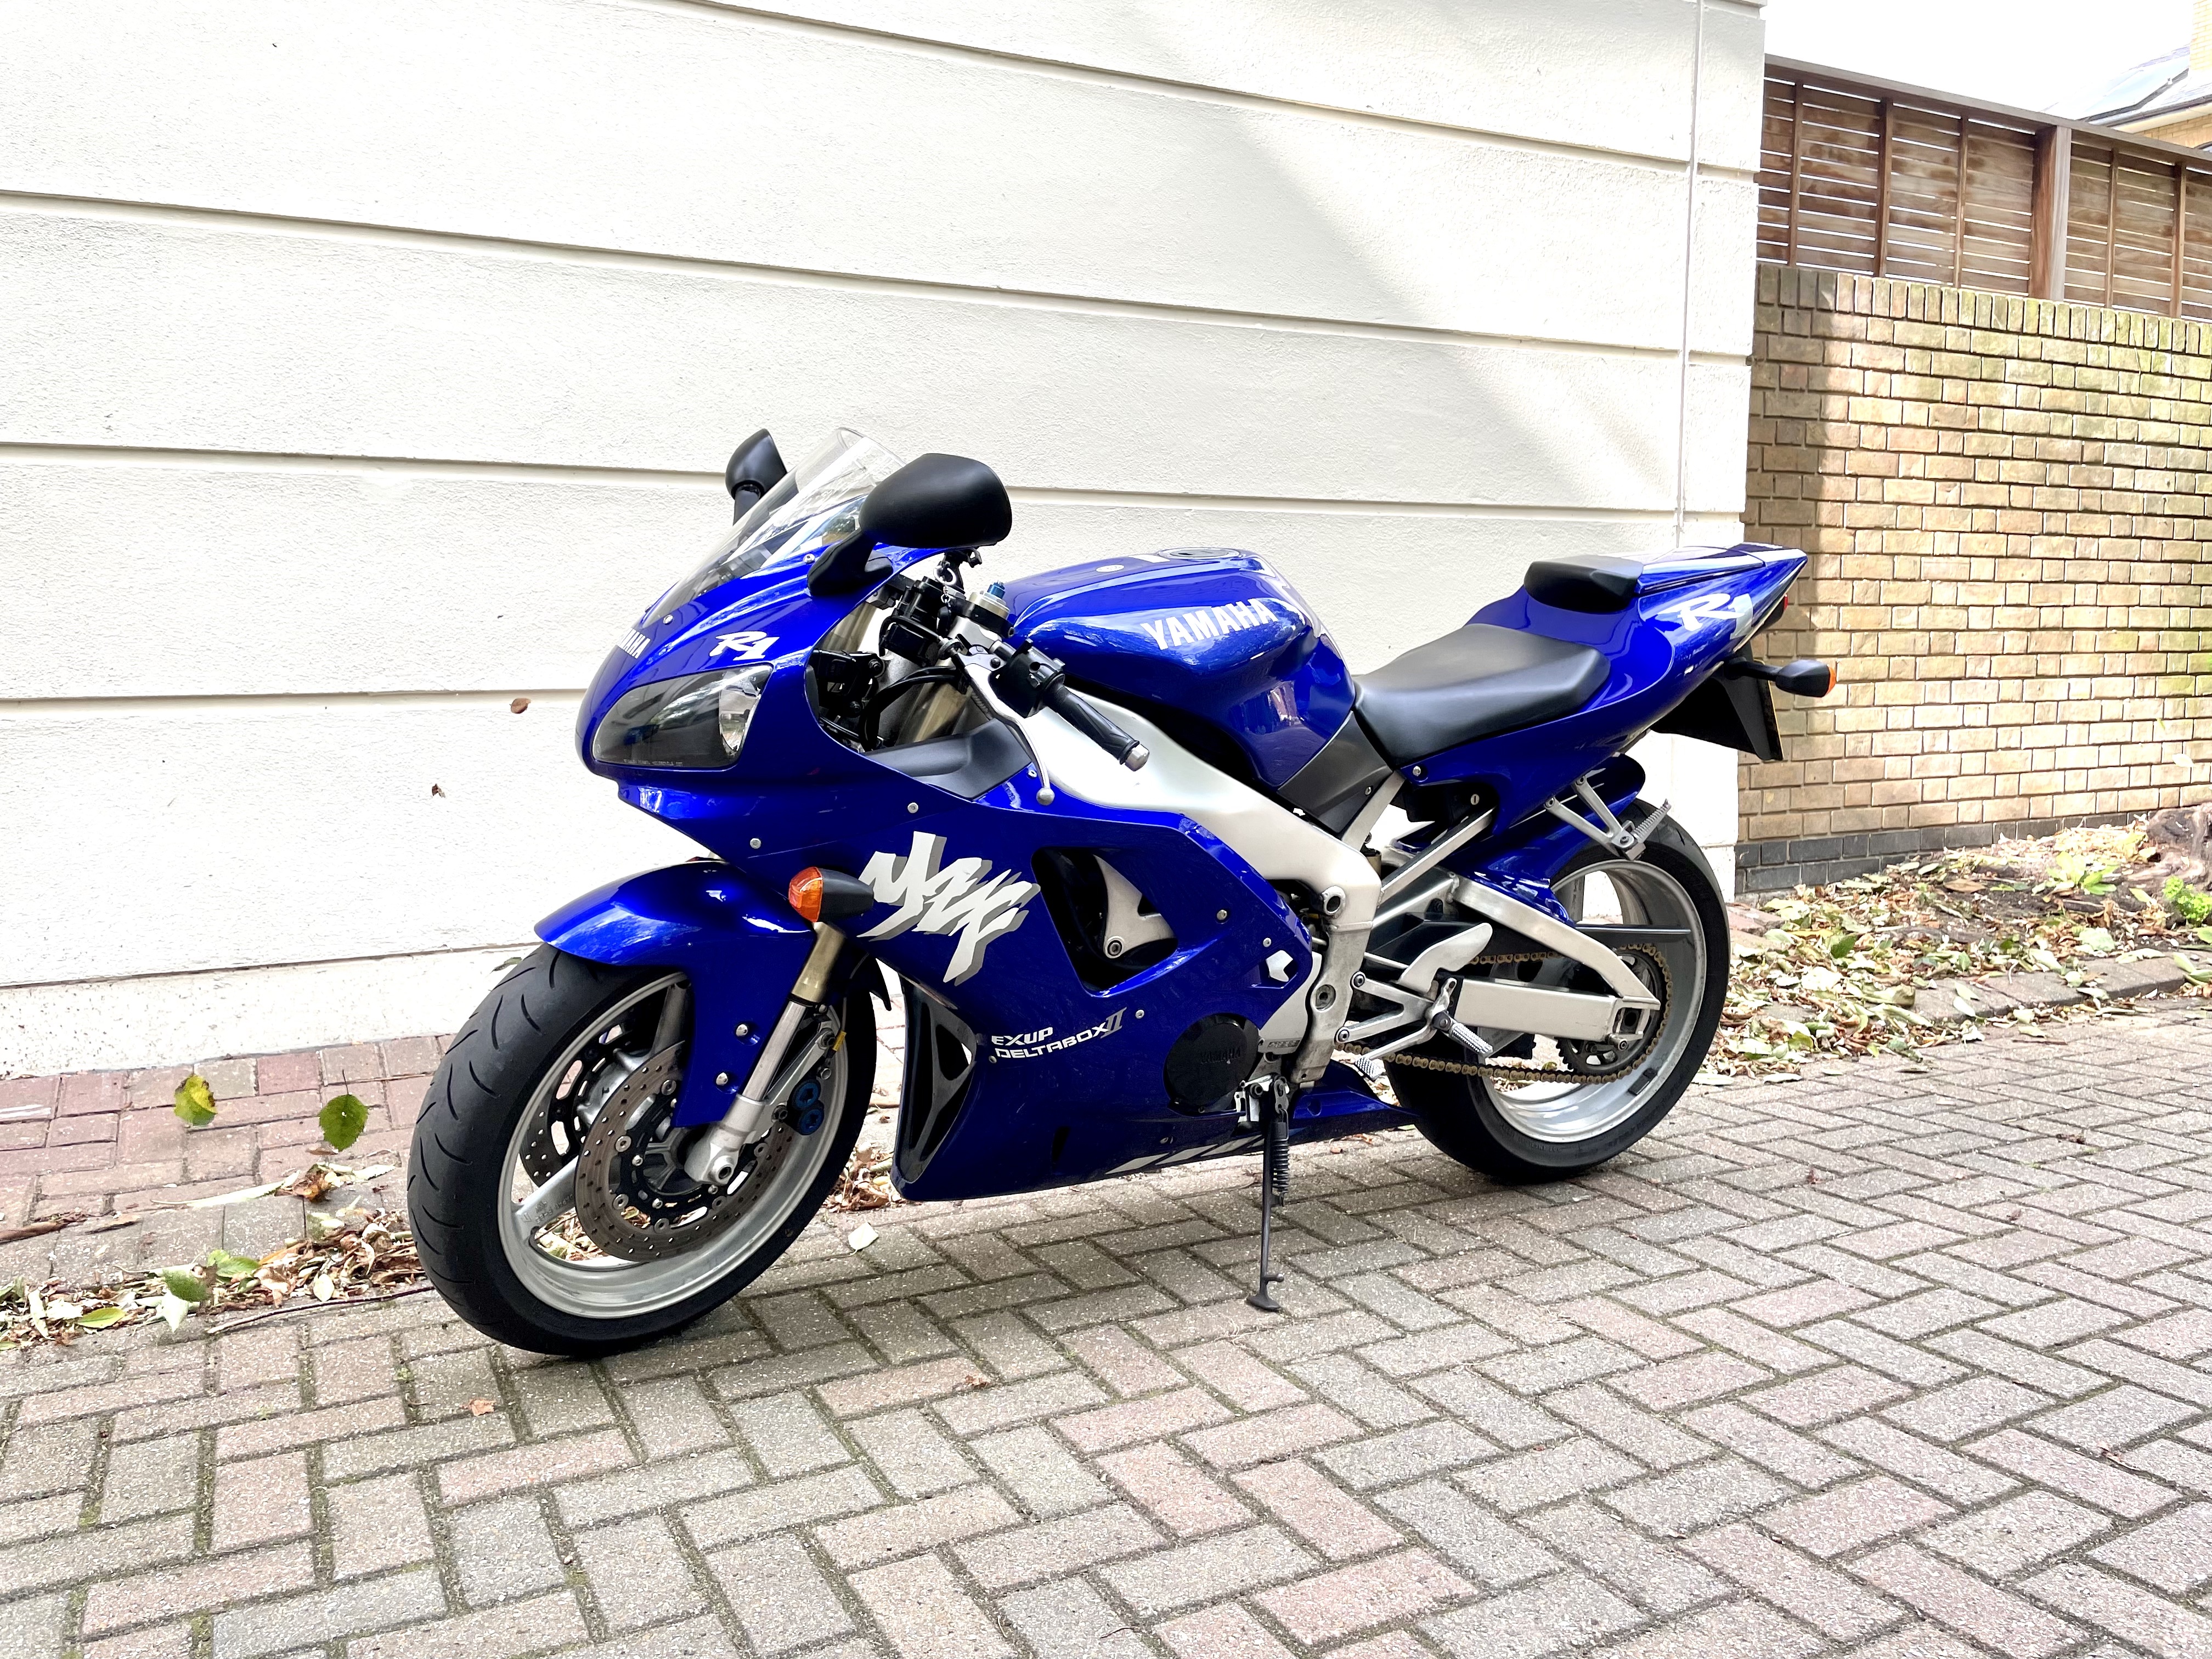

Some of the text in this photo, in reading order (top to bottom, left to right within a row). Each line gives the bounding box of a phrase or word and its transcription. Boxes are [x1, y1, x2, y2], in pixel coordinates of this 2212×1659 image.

[1140, 598, 1279, 650] YAMAHA
[1657, 593, 1753, 640] R1
[709, 630, 780, 661] R1
[991, 1026, 1053, 1046] EXUP
